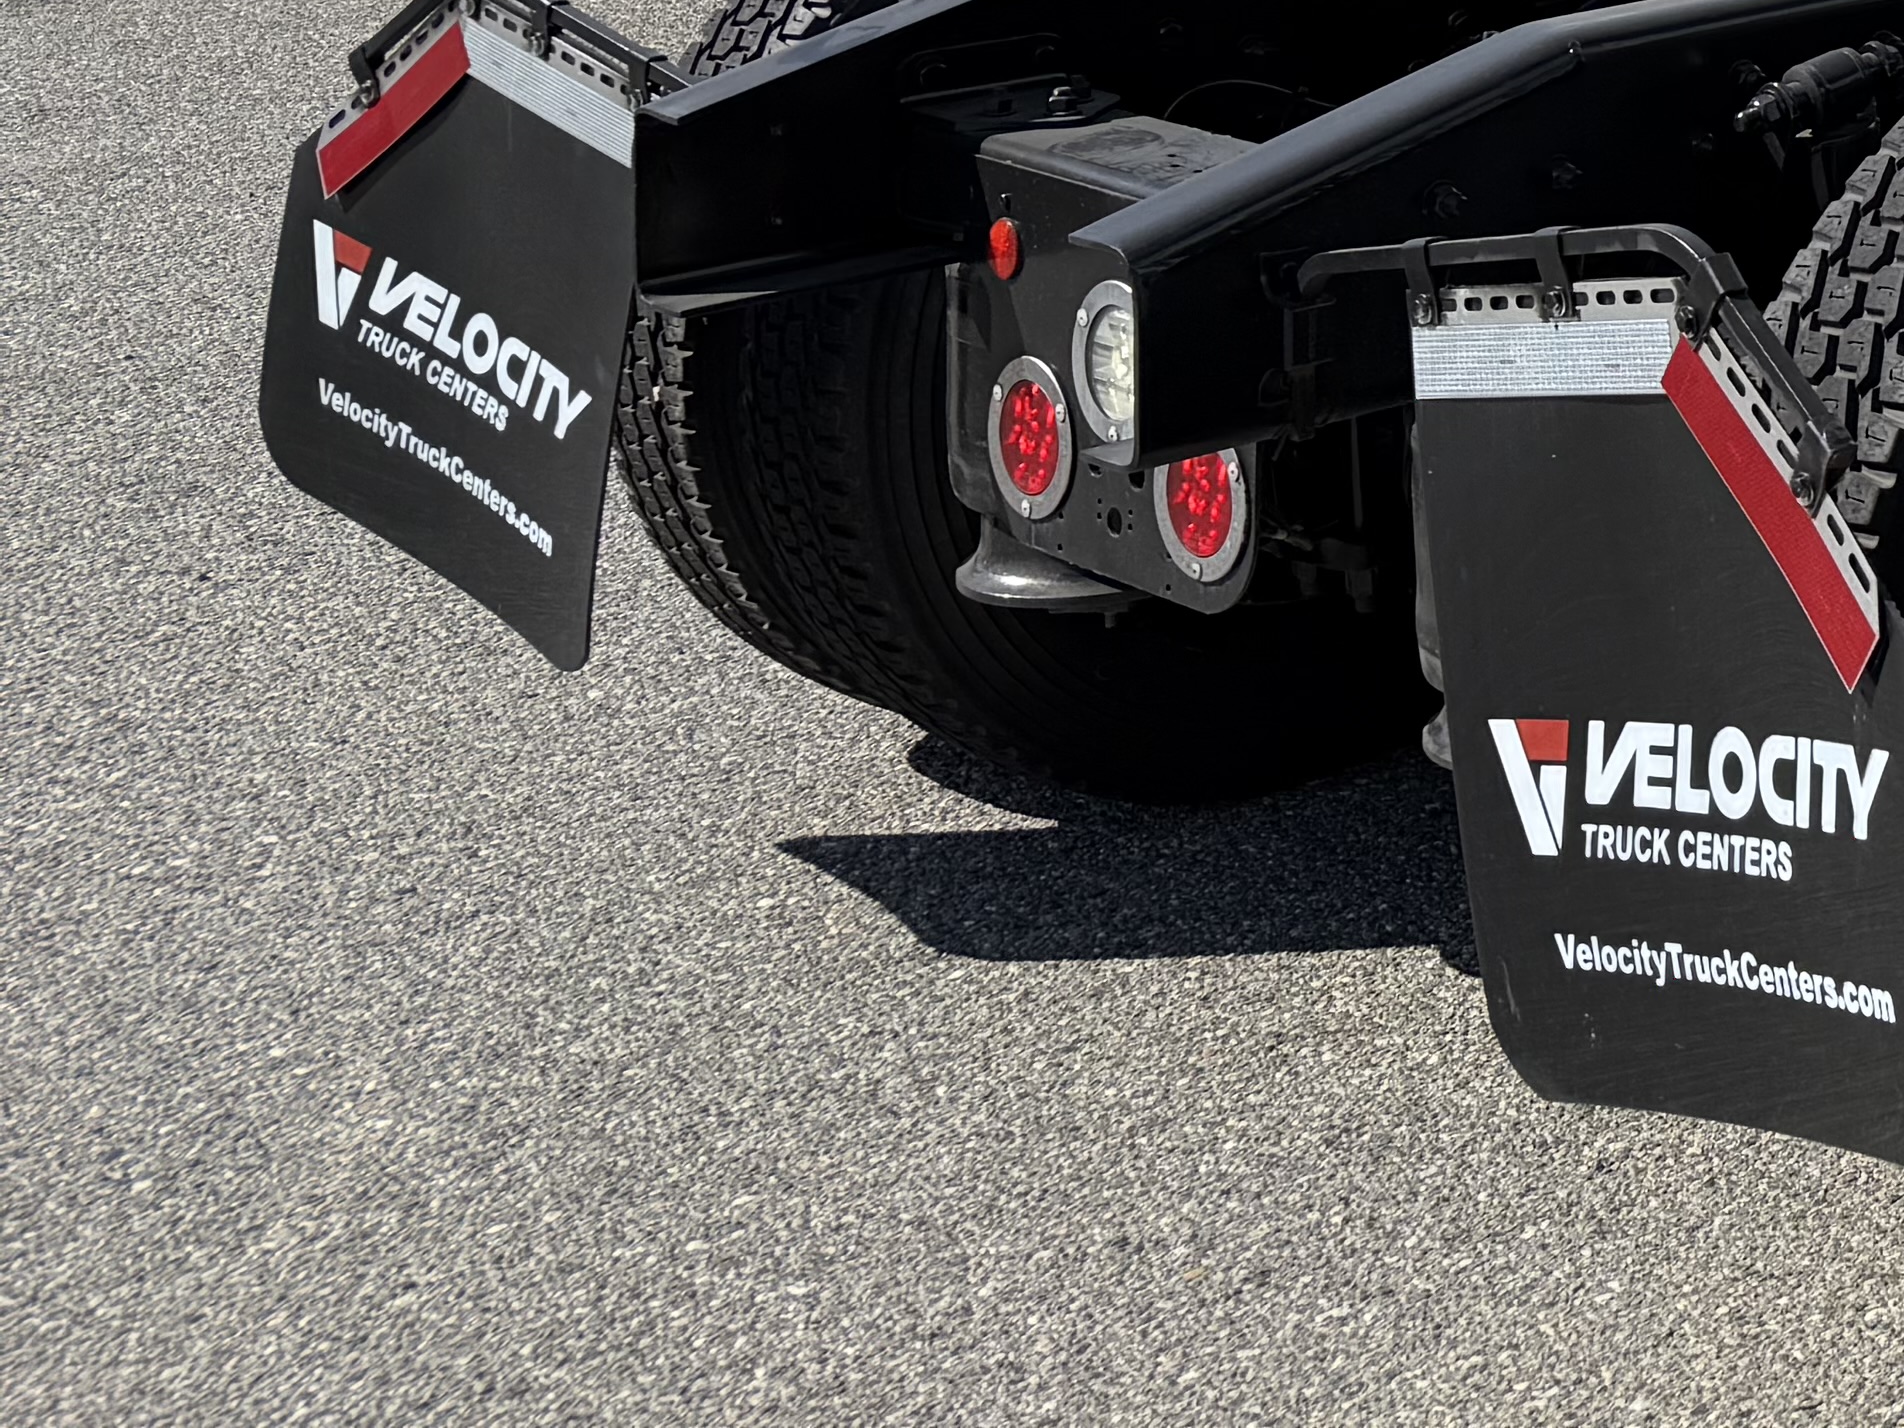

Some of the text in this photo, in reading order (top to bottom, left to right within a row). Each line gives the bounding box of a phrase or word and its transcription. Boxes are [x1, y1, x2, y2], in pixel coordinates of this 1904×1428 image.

[356, 318, 509, 432] TRUCK CENTERS
[368, 256, 593, 440] VELOCITY
[318, 377, 553, 557] VelocityTruckCenters.com
[1584, 719, 1890, 841] VELOCITY
[1580, 823, 1794, 882] TRUCK CENTERS
[1553, 933, 1896, 1024] VelocityTruckCenters.com
